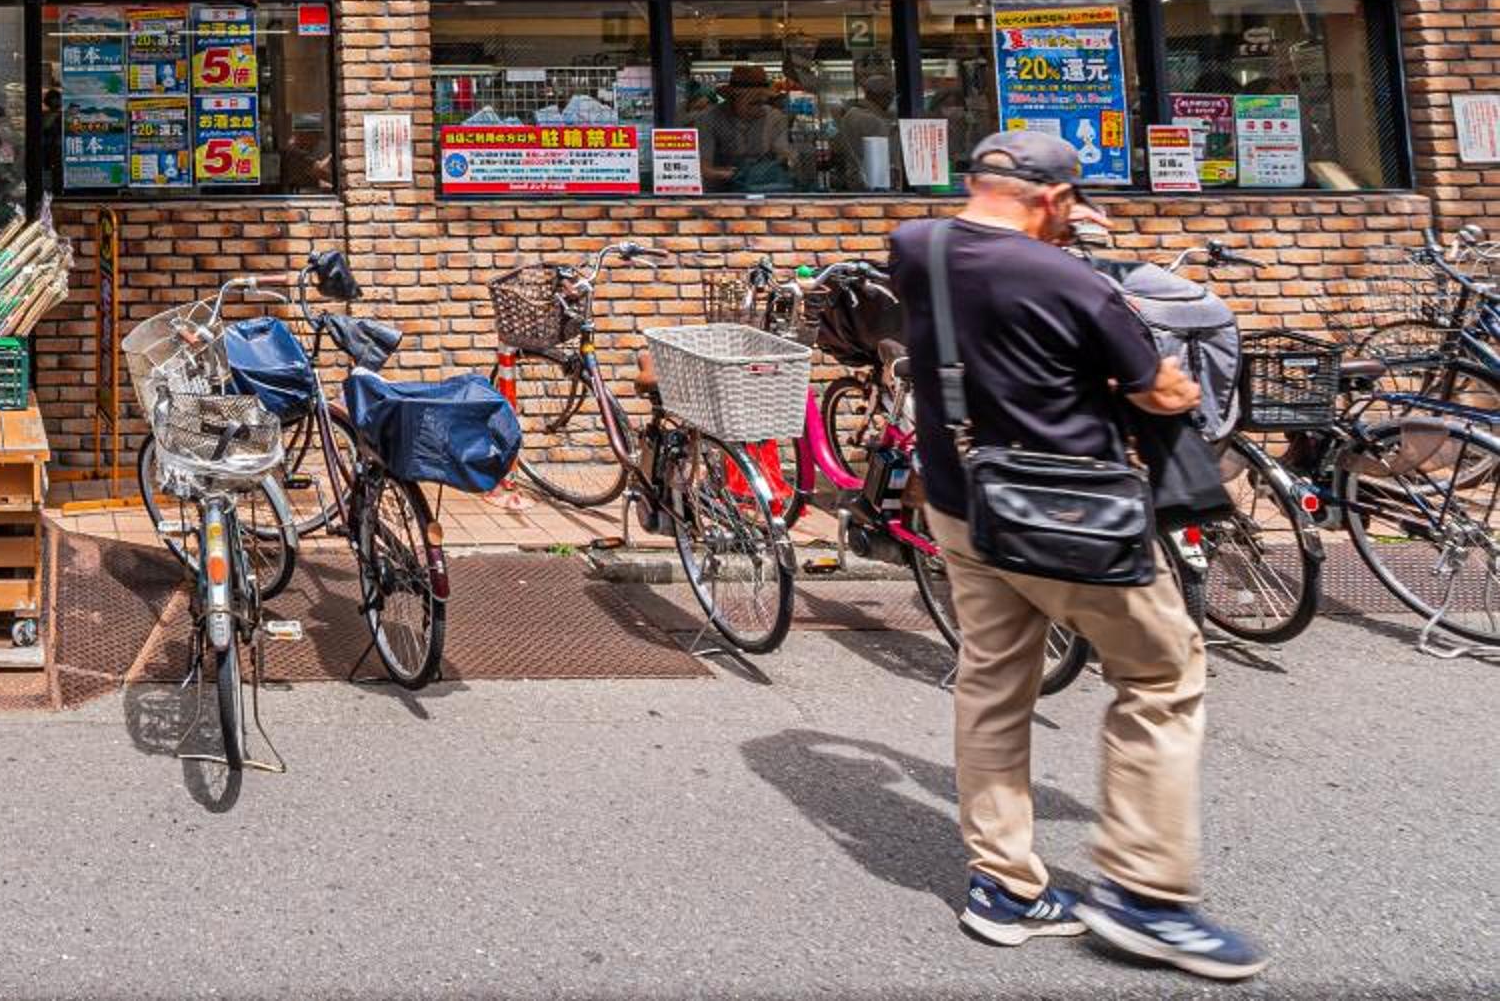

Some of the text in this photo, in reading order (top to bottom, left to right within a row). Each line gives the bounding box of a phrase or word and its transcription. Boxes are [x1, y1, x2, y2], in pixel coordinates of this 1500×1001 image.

[851, 20, 869, 42] 2
[199, 114, 255, 129] お酒全品
[541, 128, 631, 148] 駐輪禁止
